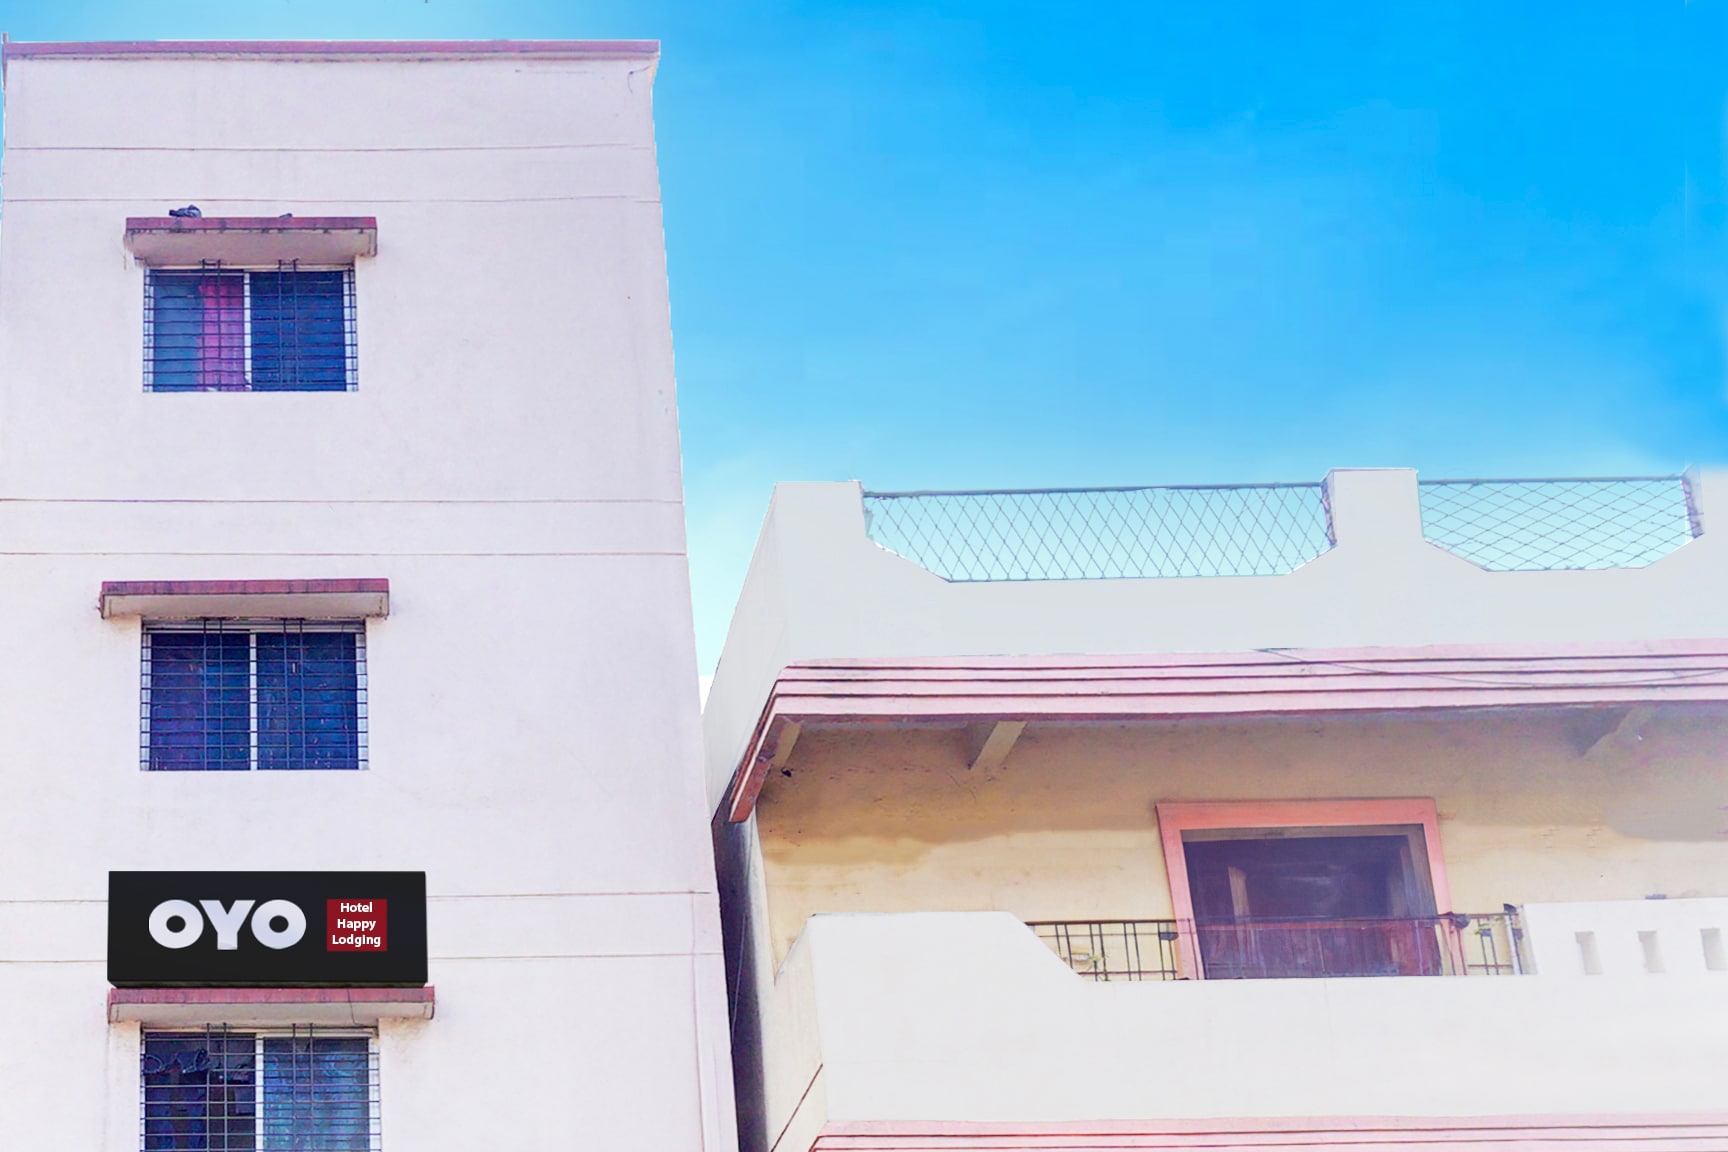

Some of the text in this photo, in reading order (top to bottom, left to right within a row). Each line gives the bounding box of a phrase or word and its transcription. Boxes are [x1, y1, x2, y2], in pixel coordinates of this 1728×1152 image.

[340, 902, 373, 913] Hotel
[149, 898, 306, 950] OYO
[337, 918, 376, 931] Happy
[332, 934, 381, 947] Lodging
